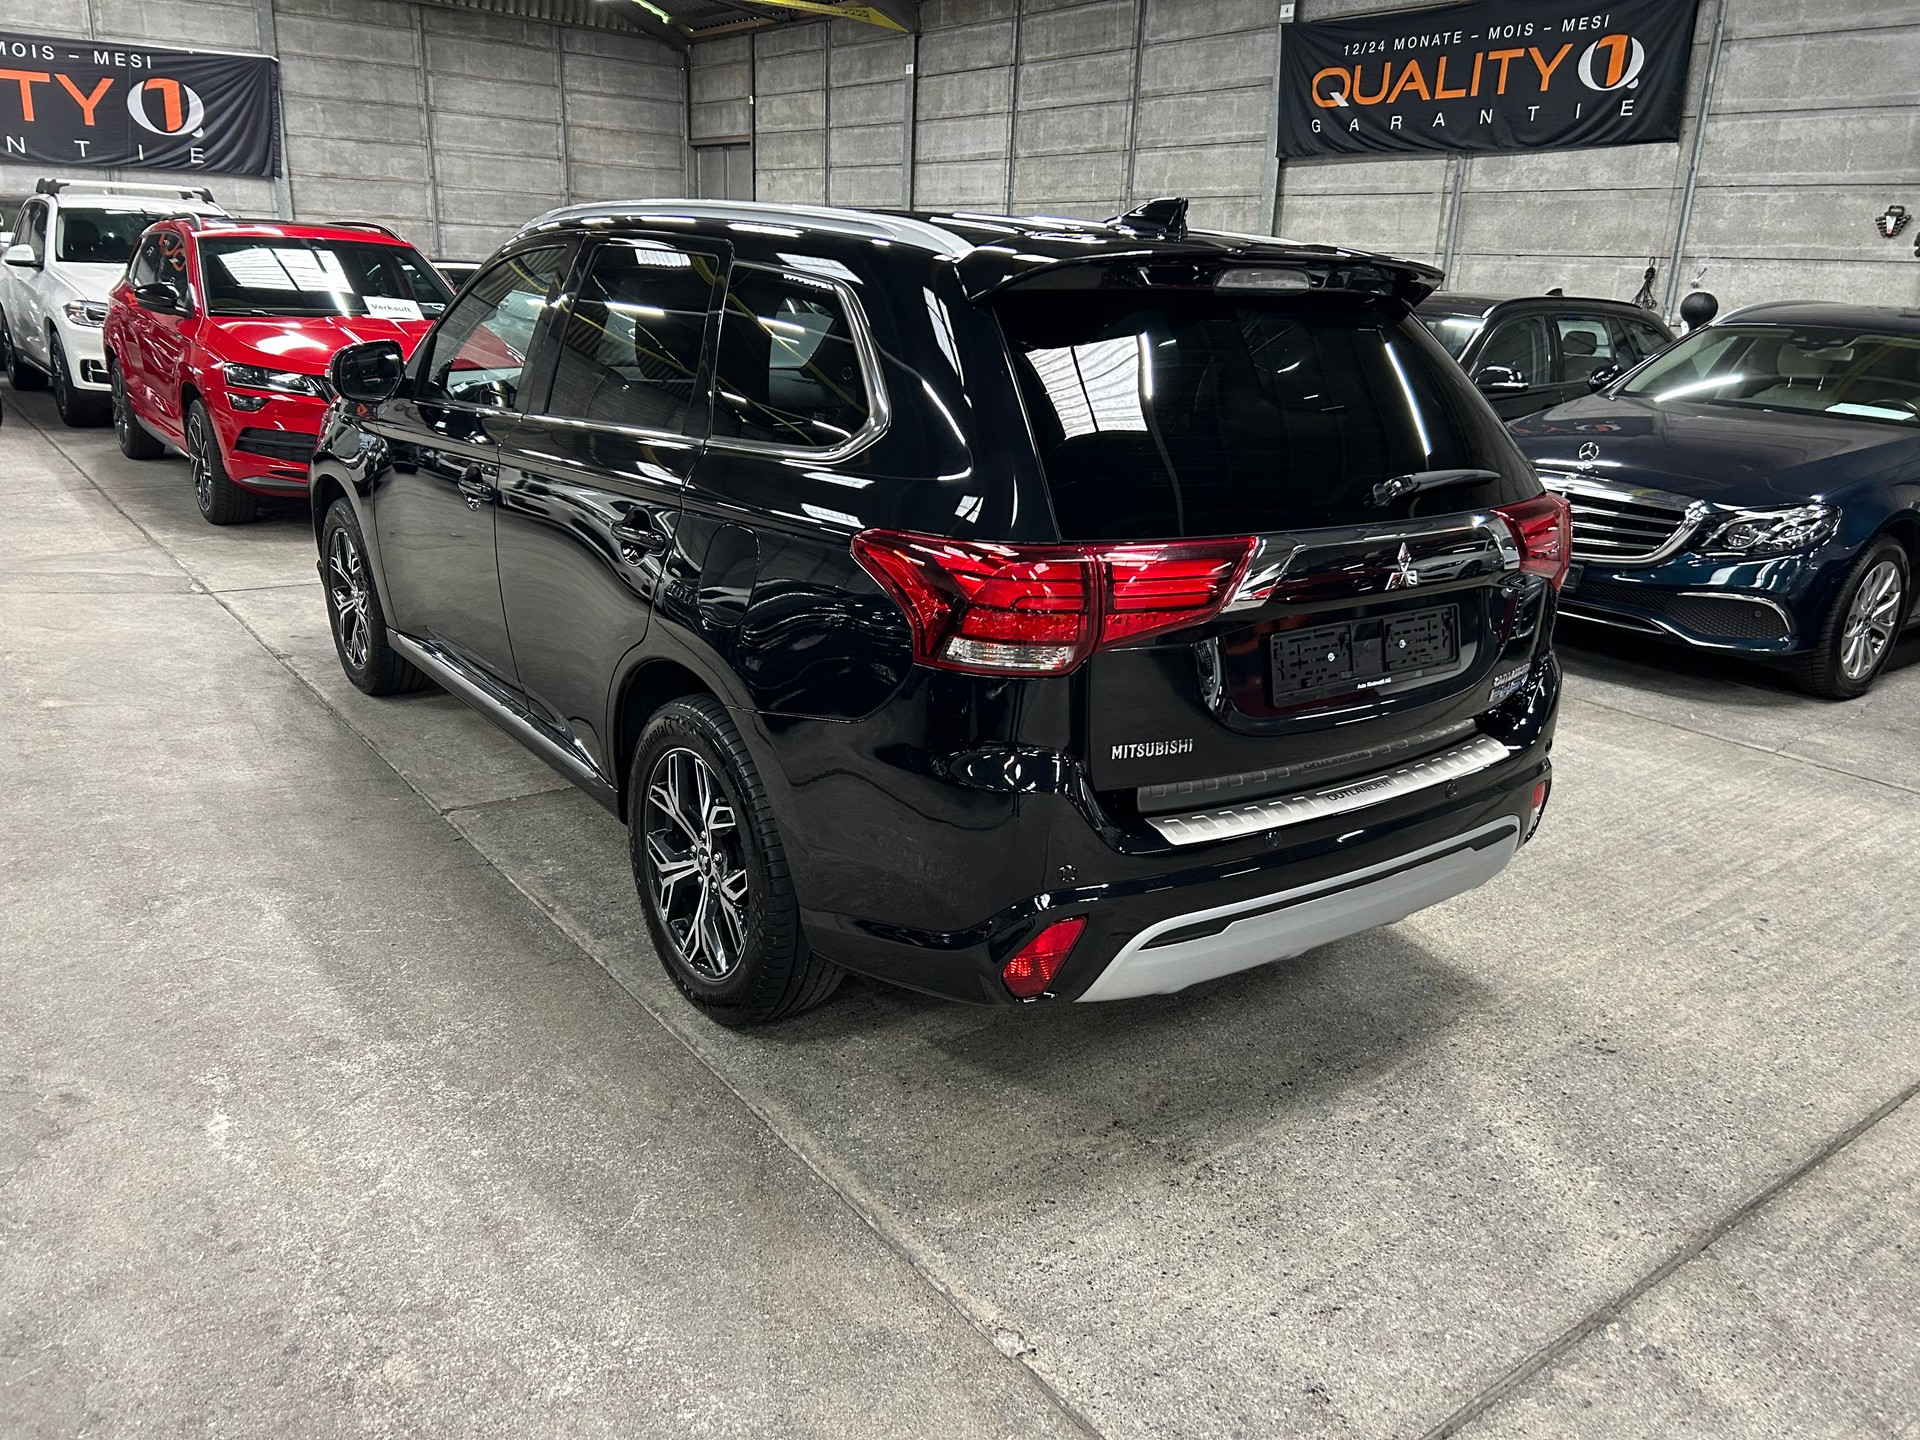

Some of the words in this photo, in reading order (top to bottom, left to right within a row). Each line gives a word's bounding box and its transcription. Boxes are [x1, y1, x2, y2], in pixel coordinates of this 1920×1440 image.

[1343, 39, 1385, 56] 12/24
[1393, 30, 1462, 51] MONATE
[1487, 22, 1534, 40] MOIS
[1561, 14, 1610, 32] MESI
[94, 50, 151, 69] MESI
[1311, 43, 1574, 108] QUALITY
[1311, 99, 1635, 133] GARANTIE
[370, 303, 411, 312] Verkauft
[1111, 738, 1193, 760] MITSUBISHI
[1326, 780, 1392, 801] OUTLANDER
